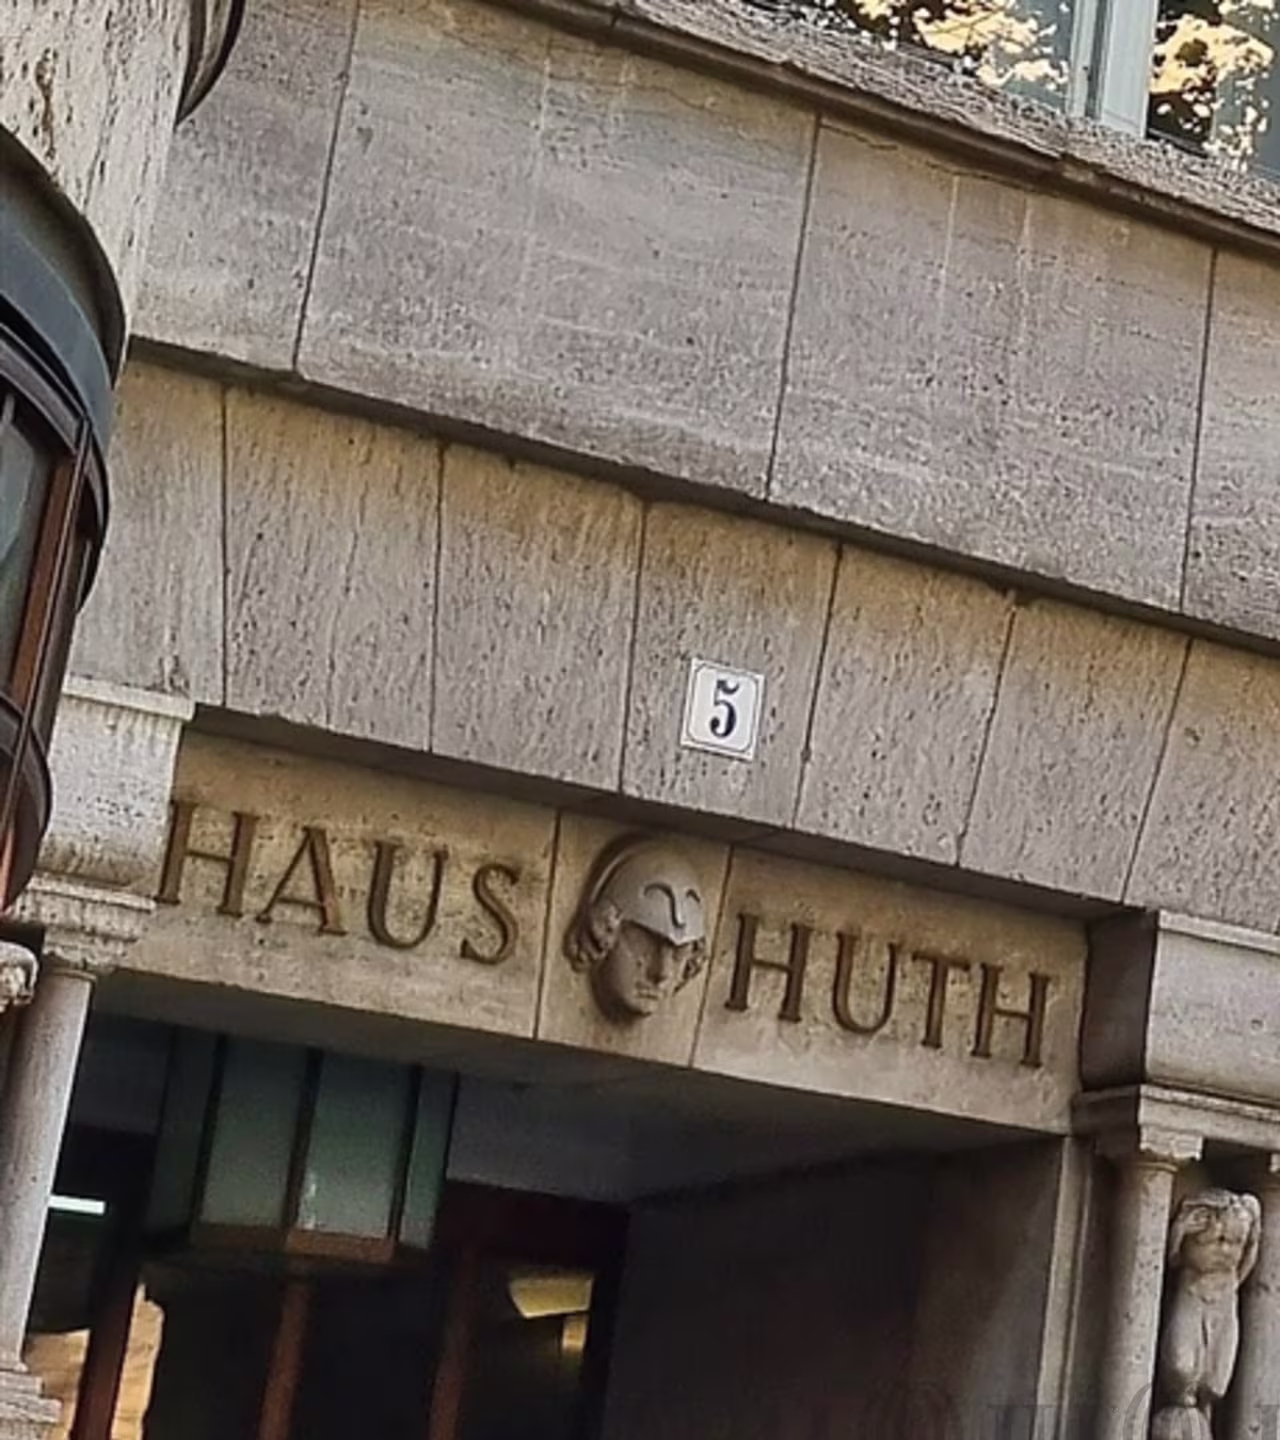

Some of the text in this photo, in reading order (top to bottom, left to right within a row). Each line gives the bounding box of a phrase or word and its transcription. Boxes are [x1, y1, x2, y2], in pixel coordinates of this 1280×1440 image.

[709, 678, 741, 739] 5
[154, 800, 1052, 1069] HAUS HUTH
